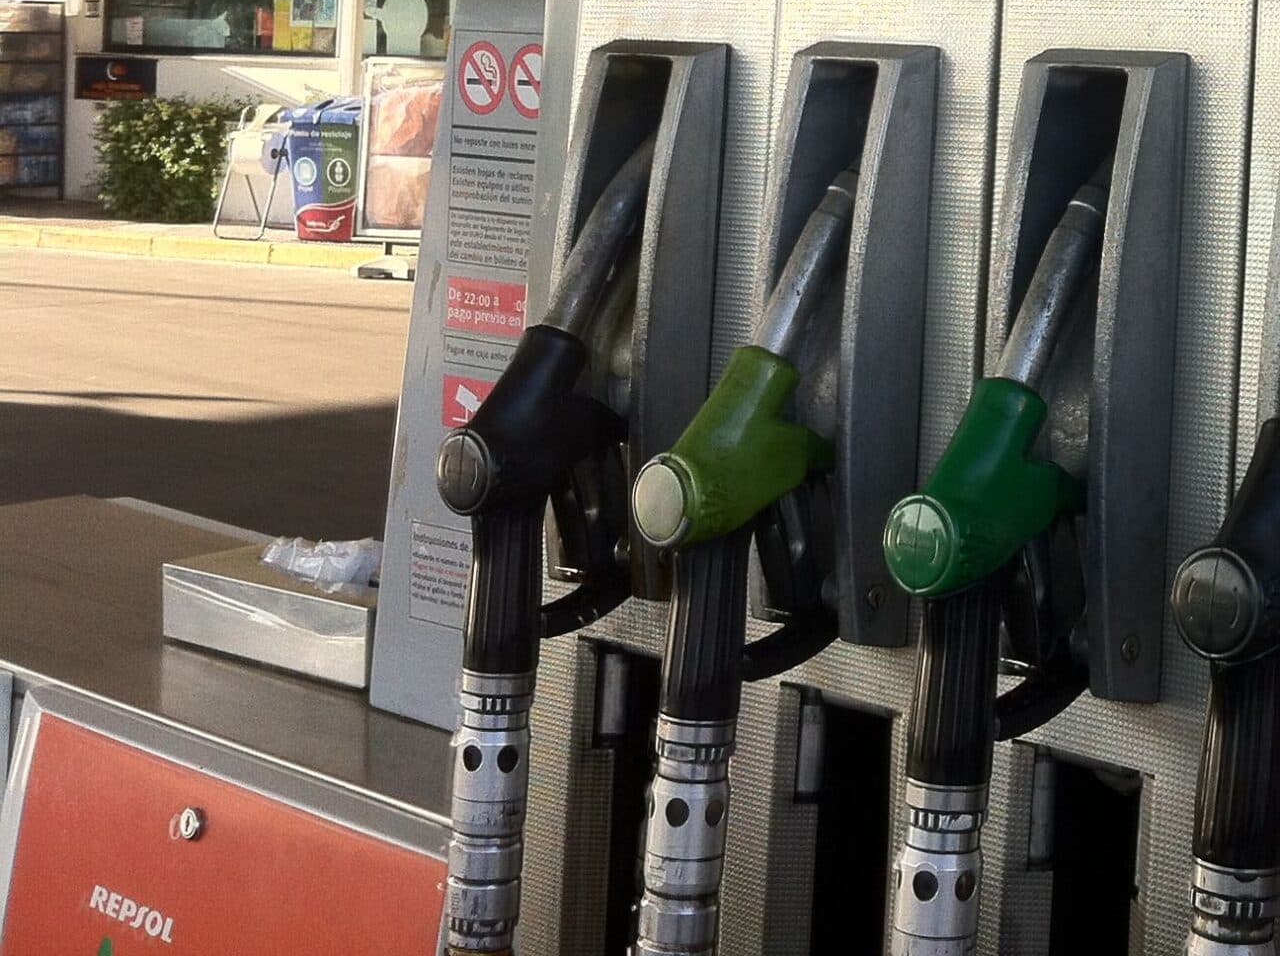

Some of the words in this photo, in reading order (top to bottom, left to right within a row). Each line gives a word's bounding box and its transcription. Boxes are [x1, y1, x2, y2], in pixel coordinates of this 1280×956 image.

[448, 287, 462, 301] De
[464, 292, 491, 308] 22:00
[448, 306, 472, 324] pago
[508, 315, 521, 327] en
[90, 884, 174, 944] REPSOL
